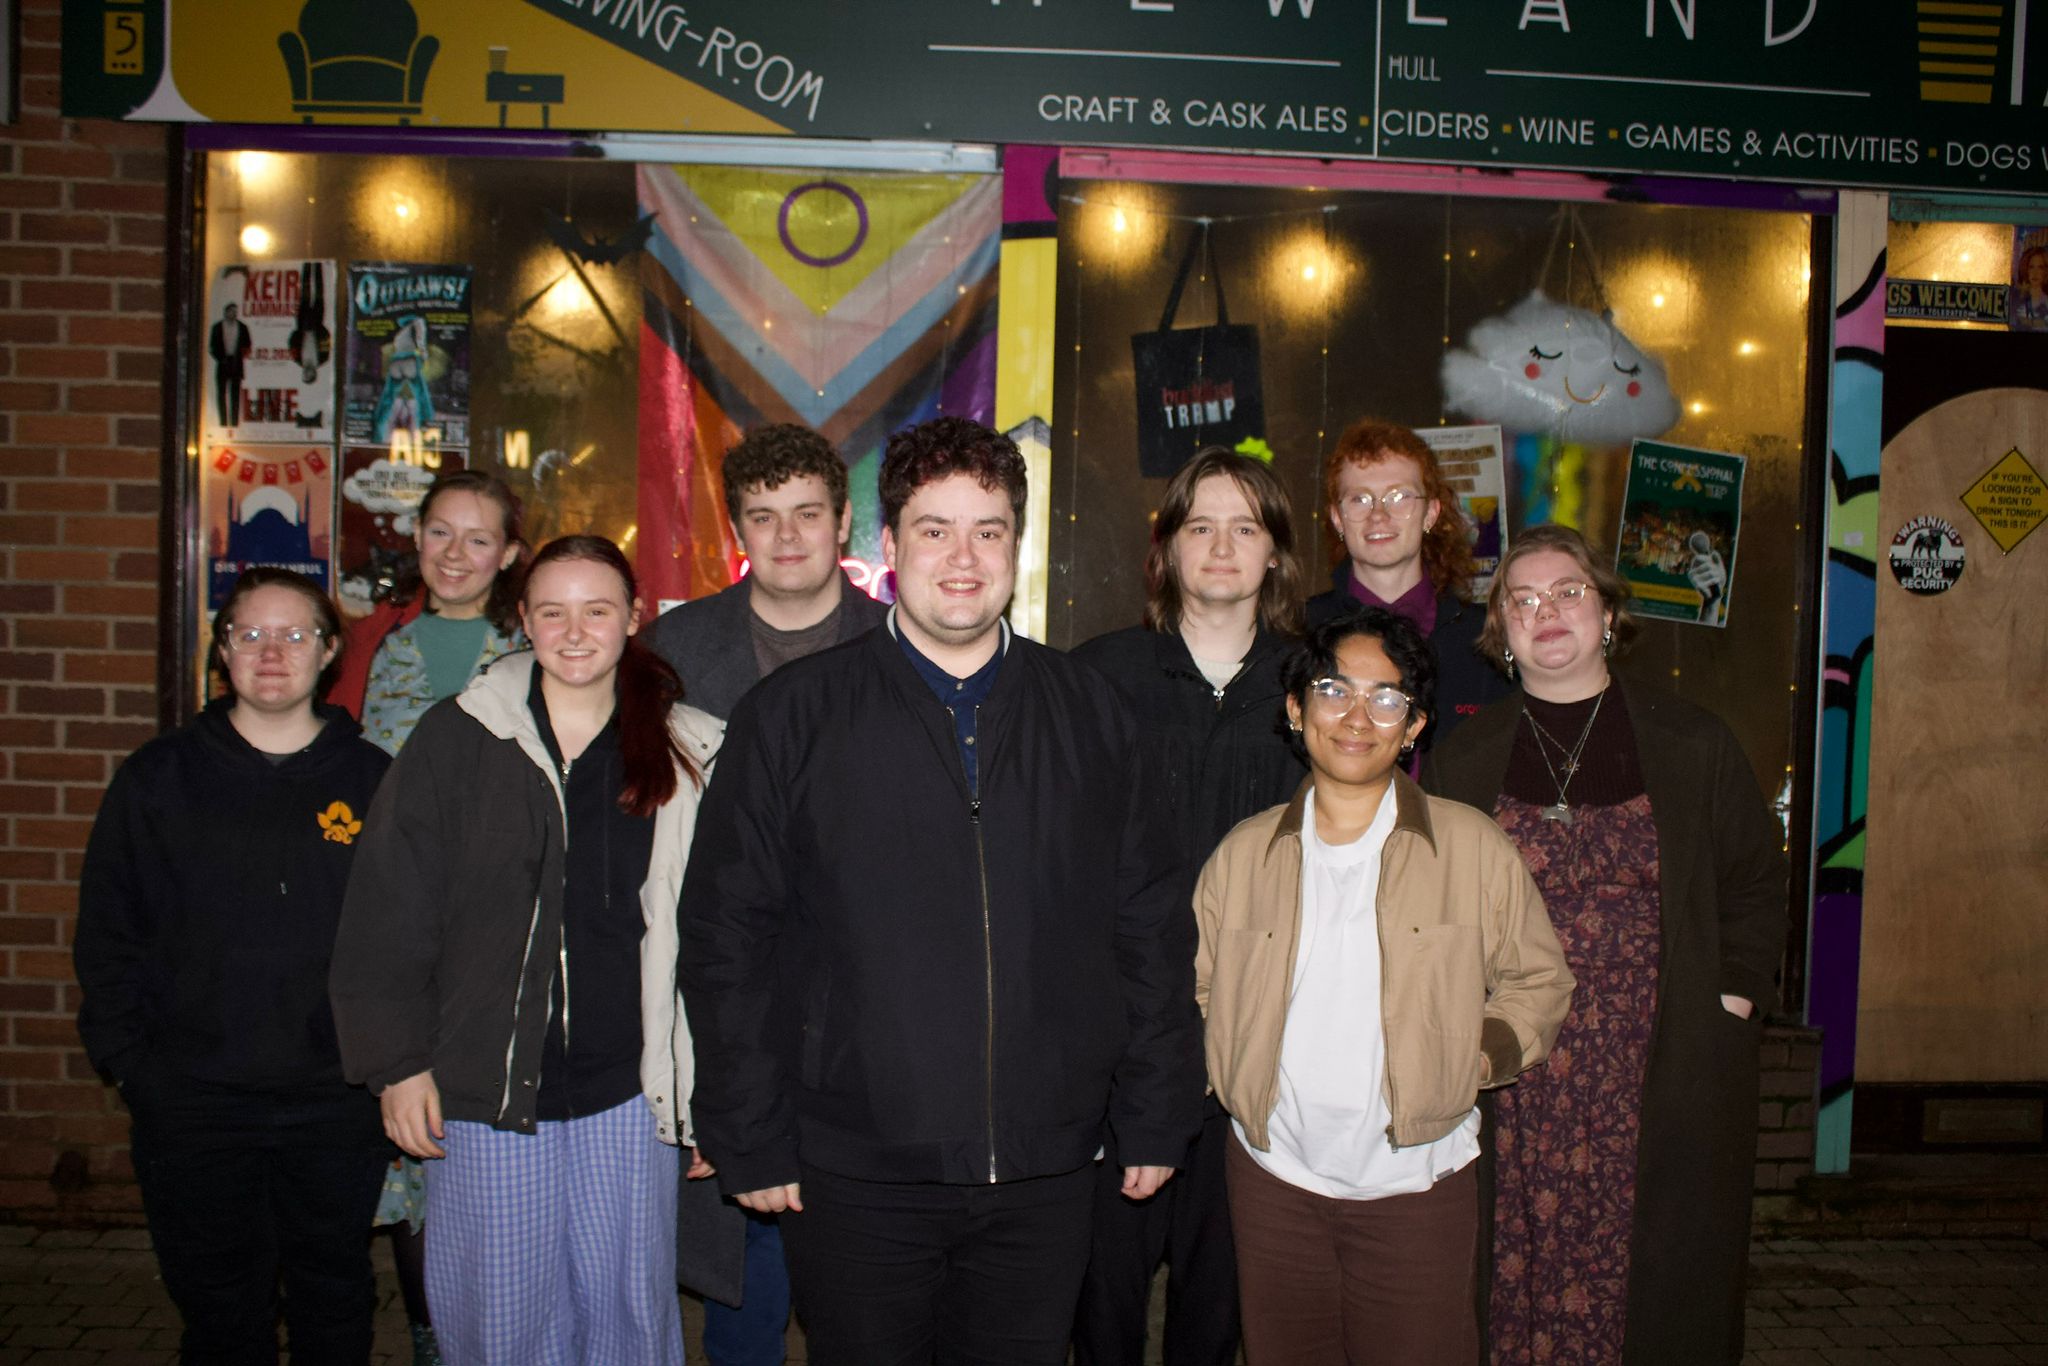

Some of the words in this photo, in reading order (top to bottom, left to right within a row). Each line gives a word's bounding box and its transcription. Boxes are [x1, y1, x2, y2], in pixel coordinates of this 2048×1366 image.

[560, 0, 824, 122] ING-ROOM
[1388, 56, 1441, 82] HULL
[1037, 93, 1138, 125] CRAFT
[1149, 99, 1172, 125] &
[1183, 101, 1267, 130] CASK
[1276, 104, 1347, 132] ALES
[1381, 109, 1490, 140] CIDERS
[1519, 116, 1595, 146] WINE
[1625, 122, 1732, 154] GAMES
[1743, 130, 1763, 156] &
[1772, 131, 1920, 165] ACTIVITIES
[1946, 141, 2031, 170] DOGS
[243, 270, 301, 302] KEIR
[1887, 283, 1912, 306] GS
[1918, 284, 2005, 318] WELCOME
[1898, 307, 1926, 316] PEOPLE
[1928, 308, 1968, 318] TOLERATED
[1164, 398, 1235, 429] TRAMP
[1638, 454, 1657, 471] THE
[1660, 459, 1736, 483] CONFESSIONAL
[1992, 473, 1999, 481] IF
[2002, 474, 2033, 482] YOU'RE
[1982, 484, 2021, 494] LOOKING
[2024, 487, 2041, 496] FOR
[1989, 496, 1996, 504] A
[1998, 497, 2018, 505] SIGN
[2021, 498, 2032, 506] TO
[1976, 507, 2002, 516] DRINK
[1899, 516, 1959, 540] WARNING
[1990, 520, 2008, 528] THIS
[2010, 520, 2018, 528] IS
[1901, 560, 1943, 568] PROTECTED
[1945, 560, 1955, 568] BY
[1913, 567, 1944, 579] PUG
[1900, 579, 1954, 590] SECURITY
